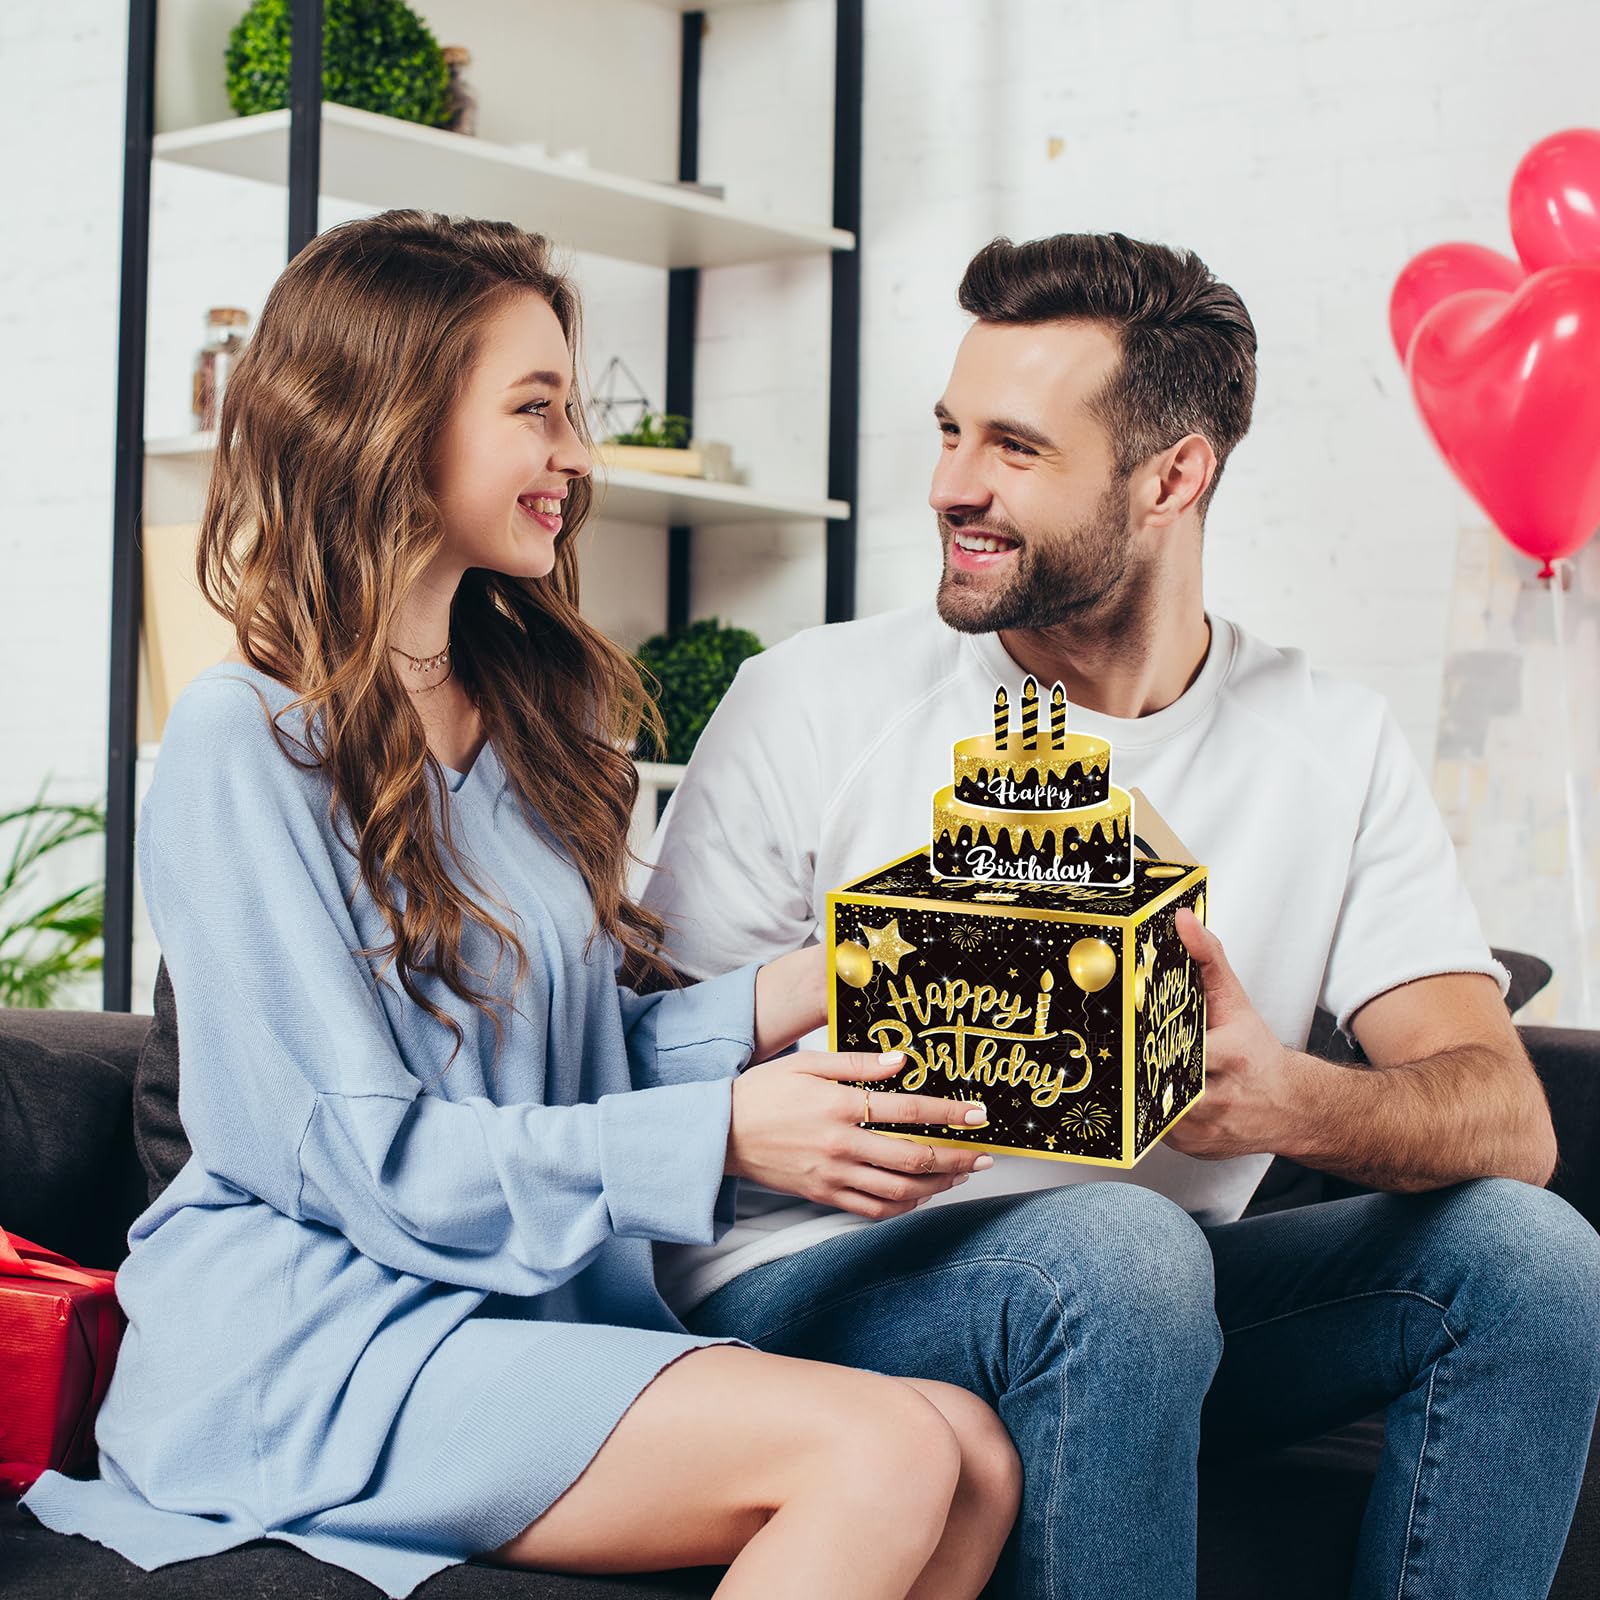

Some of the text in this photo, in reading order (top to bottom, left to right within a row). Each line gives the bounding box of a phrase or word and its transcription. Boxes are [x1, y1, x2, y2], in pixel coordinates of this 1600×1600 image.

[987, 776, 1074, 808] Happy
[965, 845, 1094, 883] Birthday
[886, 974, 1032, 1030] Happy
[1148, 967, 1186, 1031] Happy
[867, 1013, 1094, 1108] Birthday
[1143, 986, 1199, 1098] Birthday
